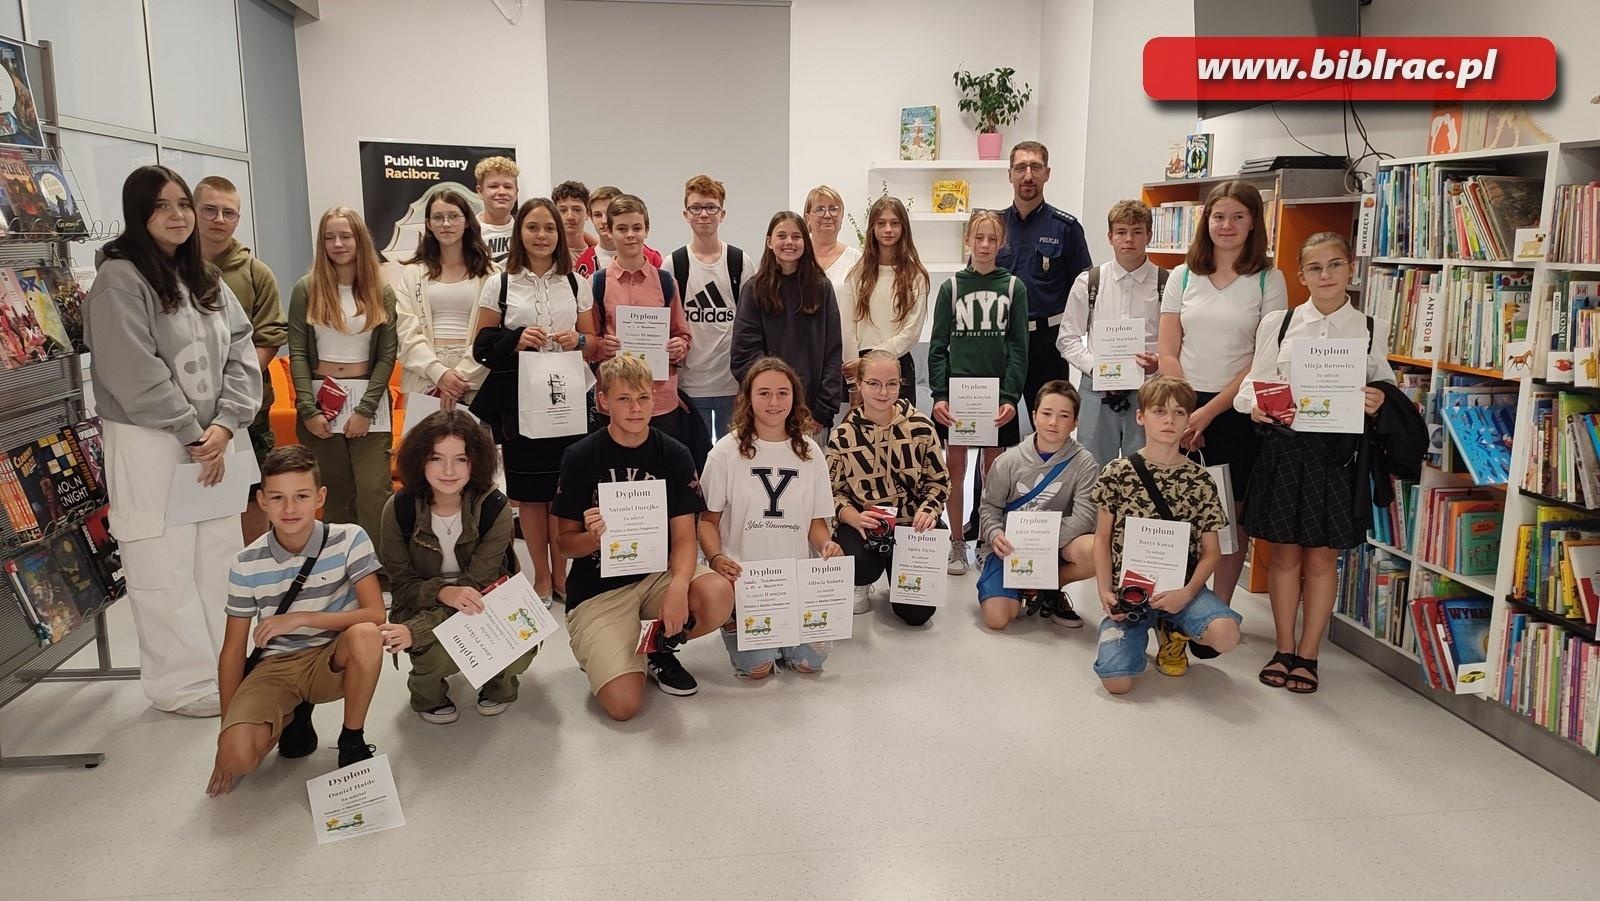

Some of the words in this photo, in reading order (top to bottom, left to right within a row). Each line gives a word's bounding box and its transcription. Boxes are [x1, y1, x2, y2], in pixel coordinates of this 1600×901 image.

[384, 155, 424, 167] Public
[425, 157, 469, 170] Library
[385, 168, 441, 180] Raciborz
[488, 236, 512, 253] NIK
[1039, 236, 1060, 244] POLICJA
[955, 290, 1011, 331] NYC
[630, 312, 658, 321] Dyplom
[1106, 325, 1133, 333] Dyplom
[1559, 311, 1568, 344] KONIE
[1310, 347, 1349, 356] Dyplom
[961, 383, 988, 391] Dyplom
[615, 489, 651, 499] Dyplom
[750, 467, 799, 518] Y
[745, 520, 764, 531] Yale
[765, 520, 800, 532] University
[1020, 518, 1048, 526] Dyplom
[1141, 525, 1175, 536] Dyplom
[907, 533, 937, 542] Dyplom
[749, 567, 782, 577] Dyplom
[811, 564, 841, 574] Dyplom
[452, 634, 479, 669] Dyplom
[328, 767, 371, 787] Dyplom
[328, 787, 353, 798] Daniel
